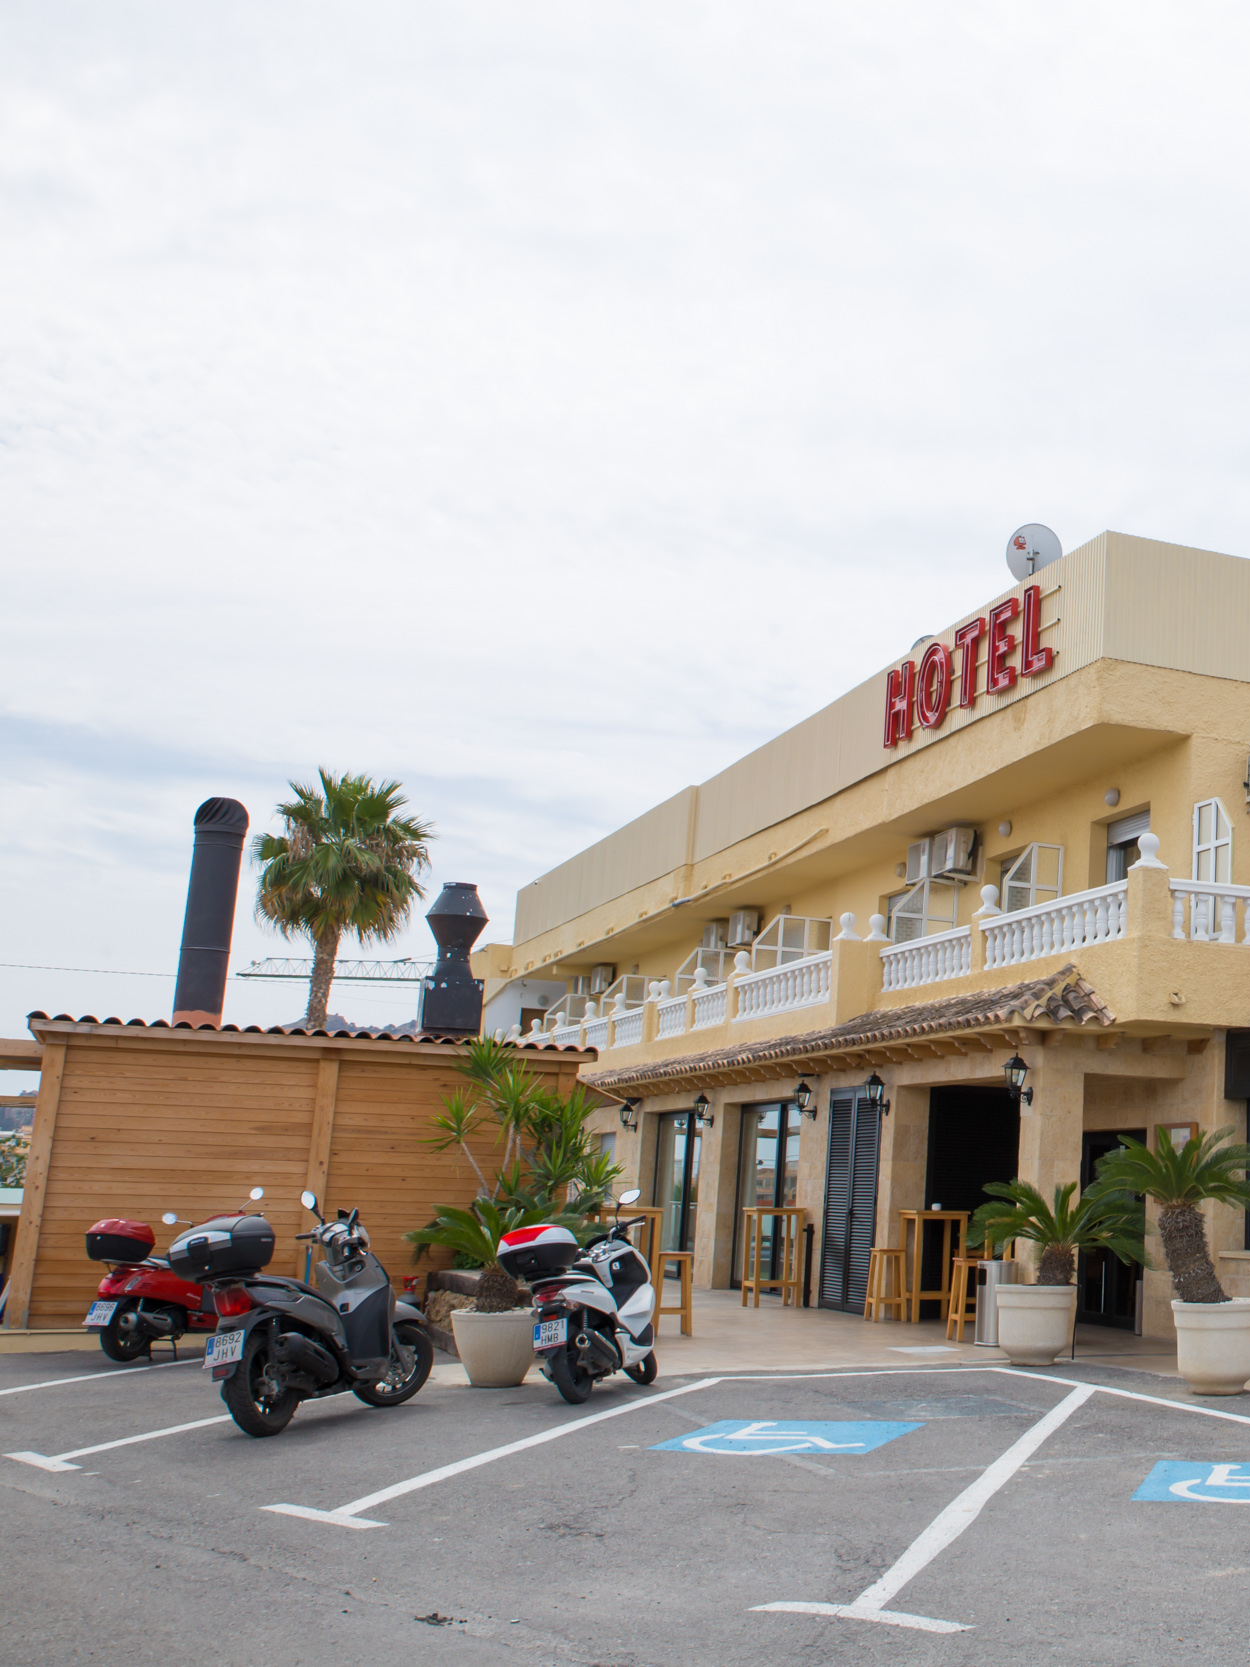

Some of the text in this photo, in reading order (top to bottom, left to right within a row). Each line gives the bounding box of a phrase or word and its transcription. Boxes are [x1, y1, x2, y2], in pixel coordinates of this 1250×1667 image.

[884, 585, 1053, 750] HOTEL
[91, 1312, 109, 1322] JHV
[541, 1319, 565, 1333] 9821
[215, 1331, 242, 1348] 8692
[541, 1333, 559, 1345] HMB
[213, 1345, 237, 1361] JHV
